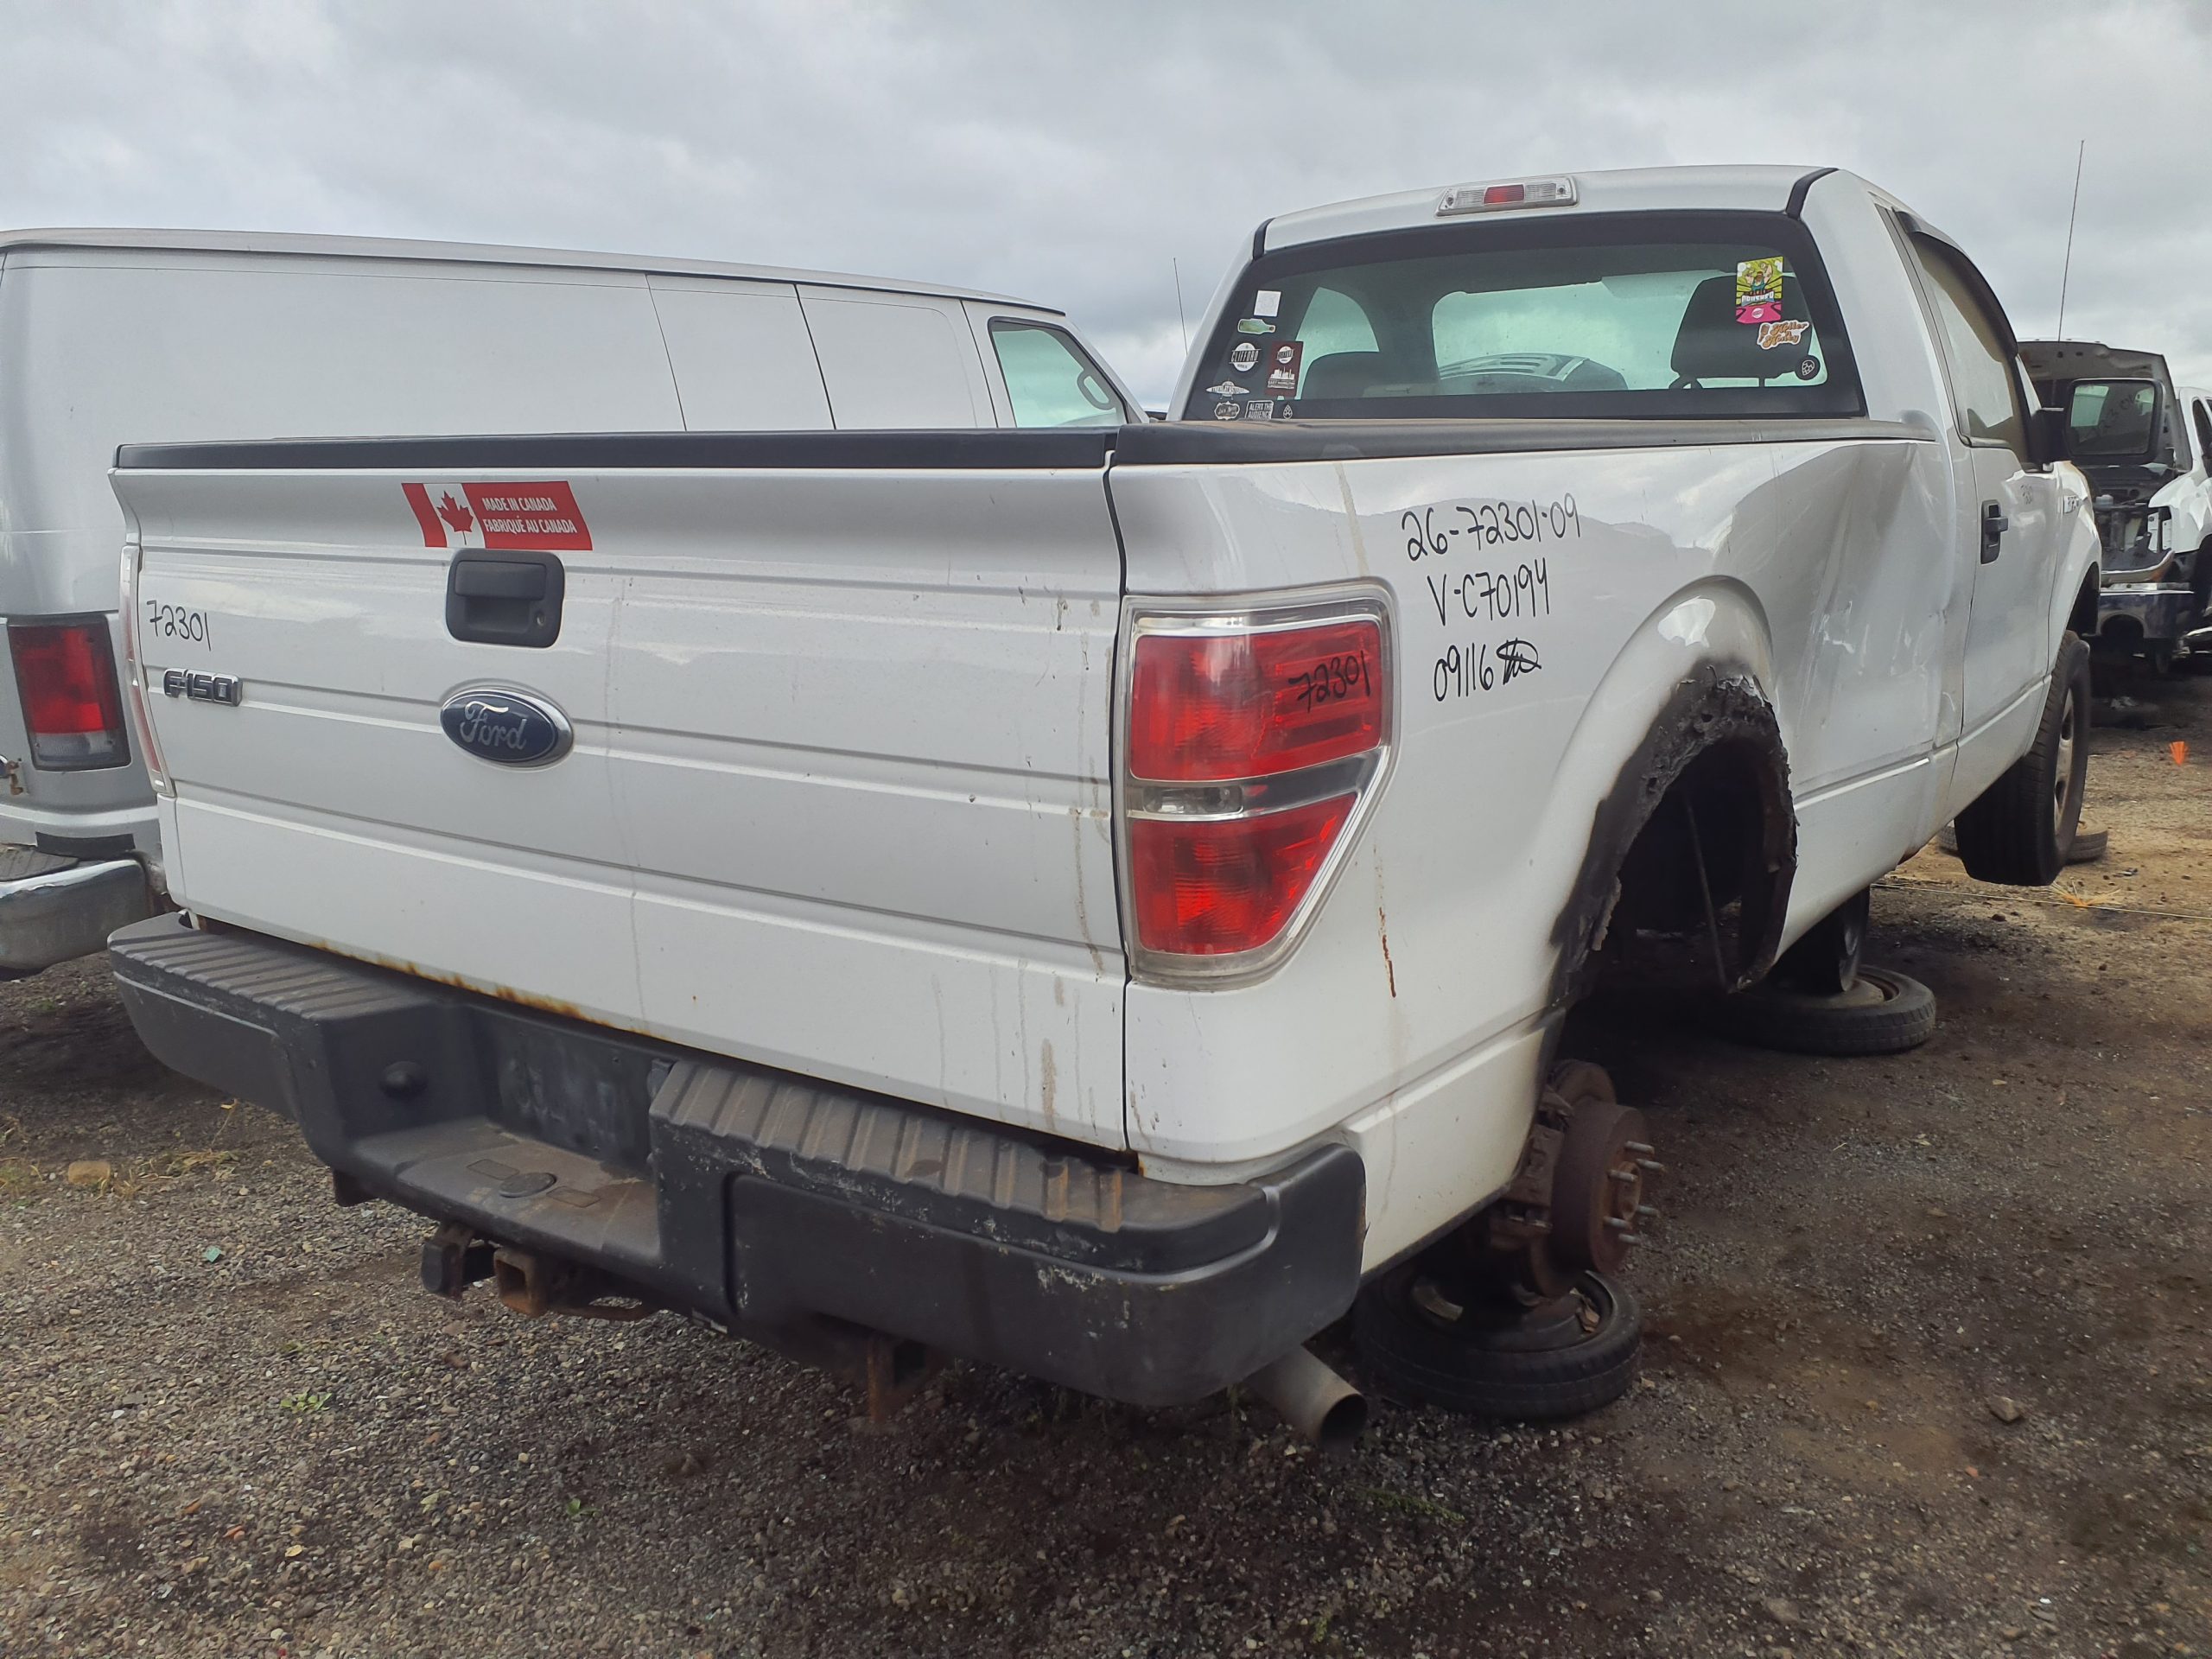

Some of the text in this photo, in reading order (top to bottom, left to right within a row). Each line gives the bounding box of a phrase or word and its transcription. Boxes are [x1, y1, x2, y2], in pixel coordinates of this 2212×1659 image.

[1230, 350, 1259, 363] CLIFFORD
[482, 498, 557, 511] MADE IN CANADA
[483, 519, 577, 534] FABRIQUE AU CANADA
[146, 600, 212, 652] 72301
[1287, 650, 1370, 714] 72301
[1433, 642, 1494, 702] 09116
[460, 700, 528, 750] Ford
